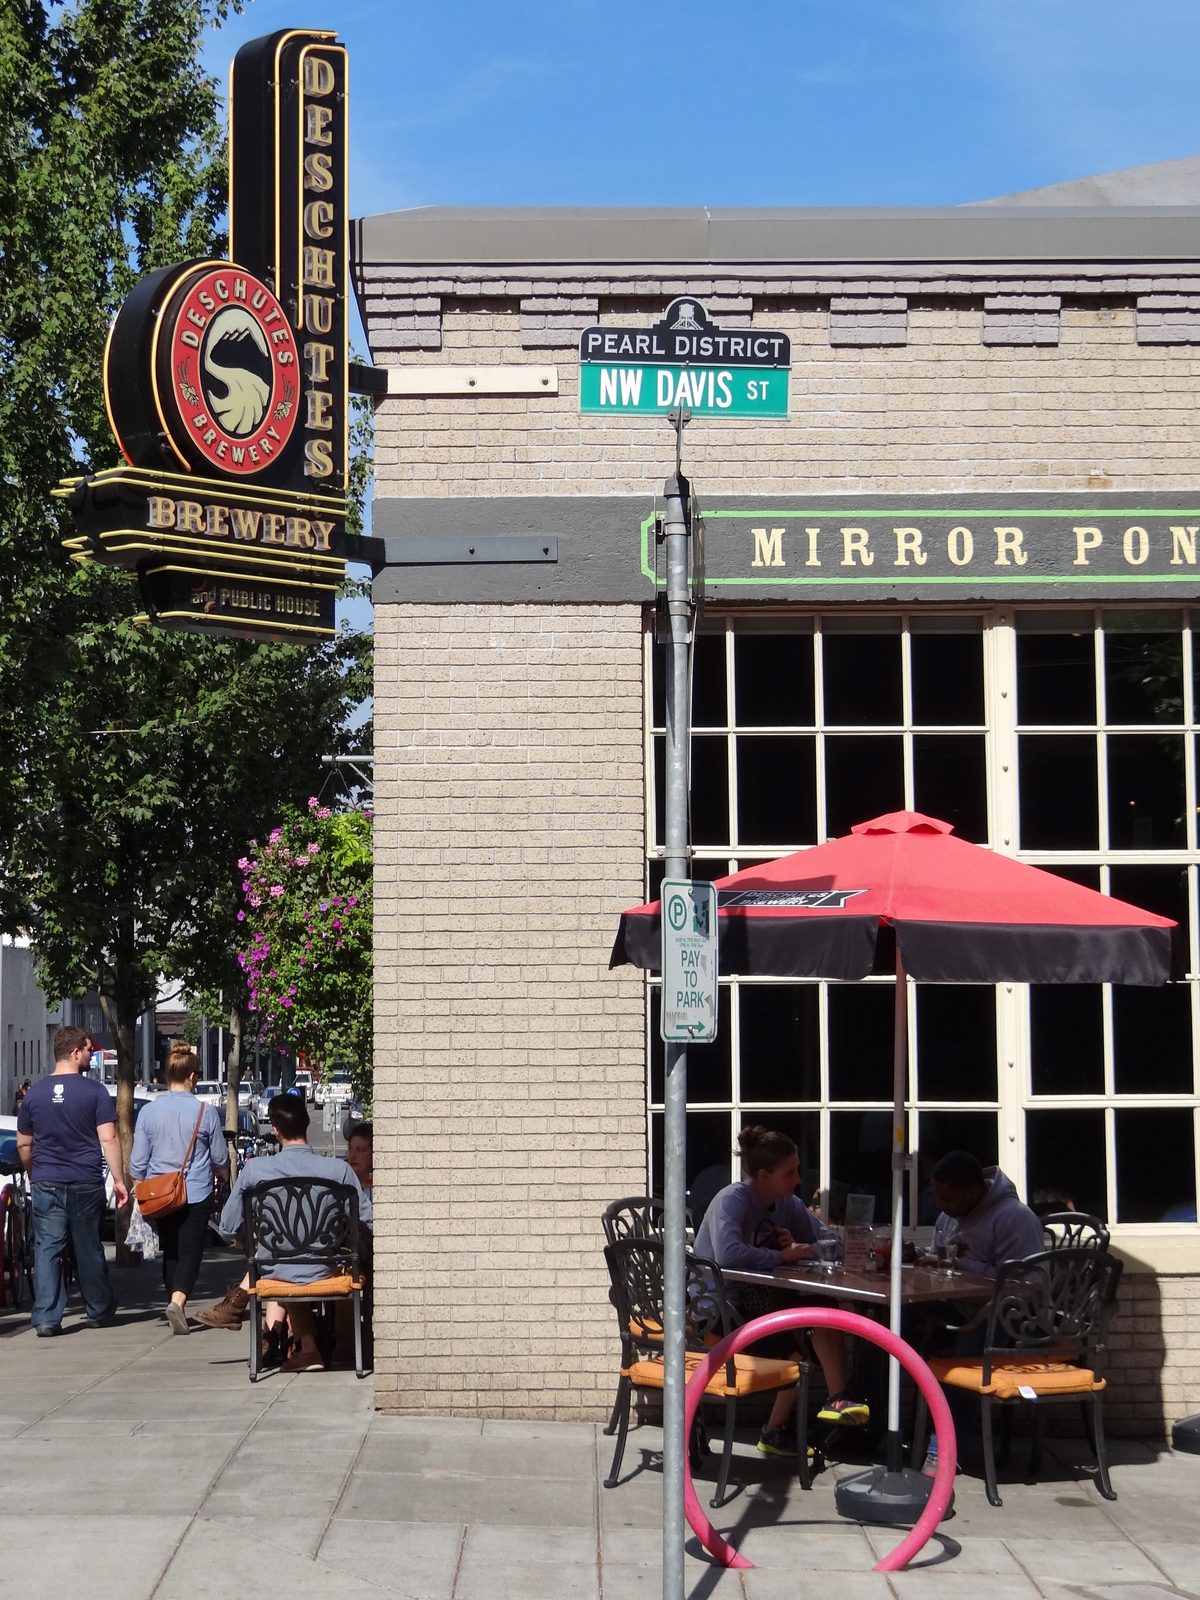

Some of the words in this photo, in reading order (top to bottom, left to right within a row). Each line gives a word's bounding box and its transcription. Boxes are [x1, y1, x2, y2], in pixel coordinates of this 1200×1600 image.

[303, 57, 336, 478] DESCHUTES
[180, 278, 295, 366] DESCHUTES
[588, 333, 666, 355] PEARL
[675, 336, 784, 358] DISTRICT
[600, 368, 643, 406] NW
[657, 370, 733, 408] DAVIS
[747, 381, 770, 400] ST
[193, 412, 281, 465] BREWERY
[147, 496, 336, 551] BREWERY
[751, 526, 1028, 567] MIRROR
[1072, 526, 1199, 566] PON
[191, 586, 216, 604] and
[220, 588, 272, 611] PUBLIC
[275, 595, 321, 617] HOUSE
[681, 950, 701, 968] PAY
[684, 970, 698, 988] TO
[676, 991, 704, 1008] PARK
